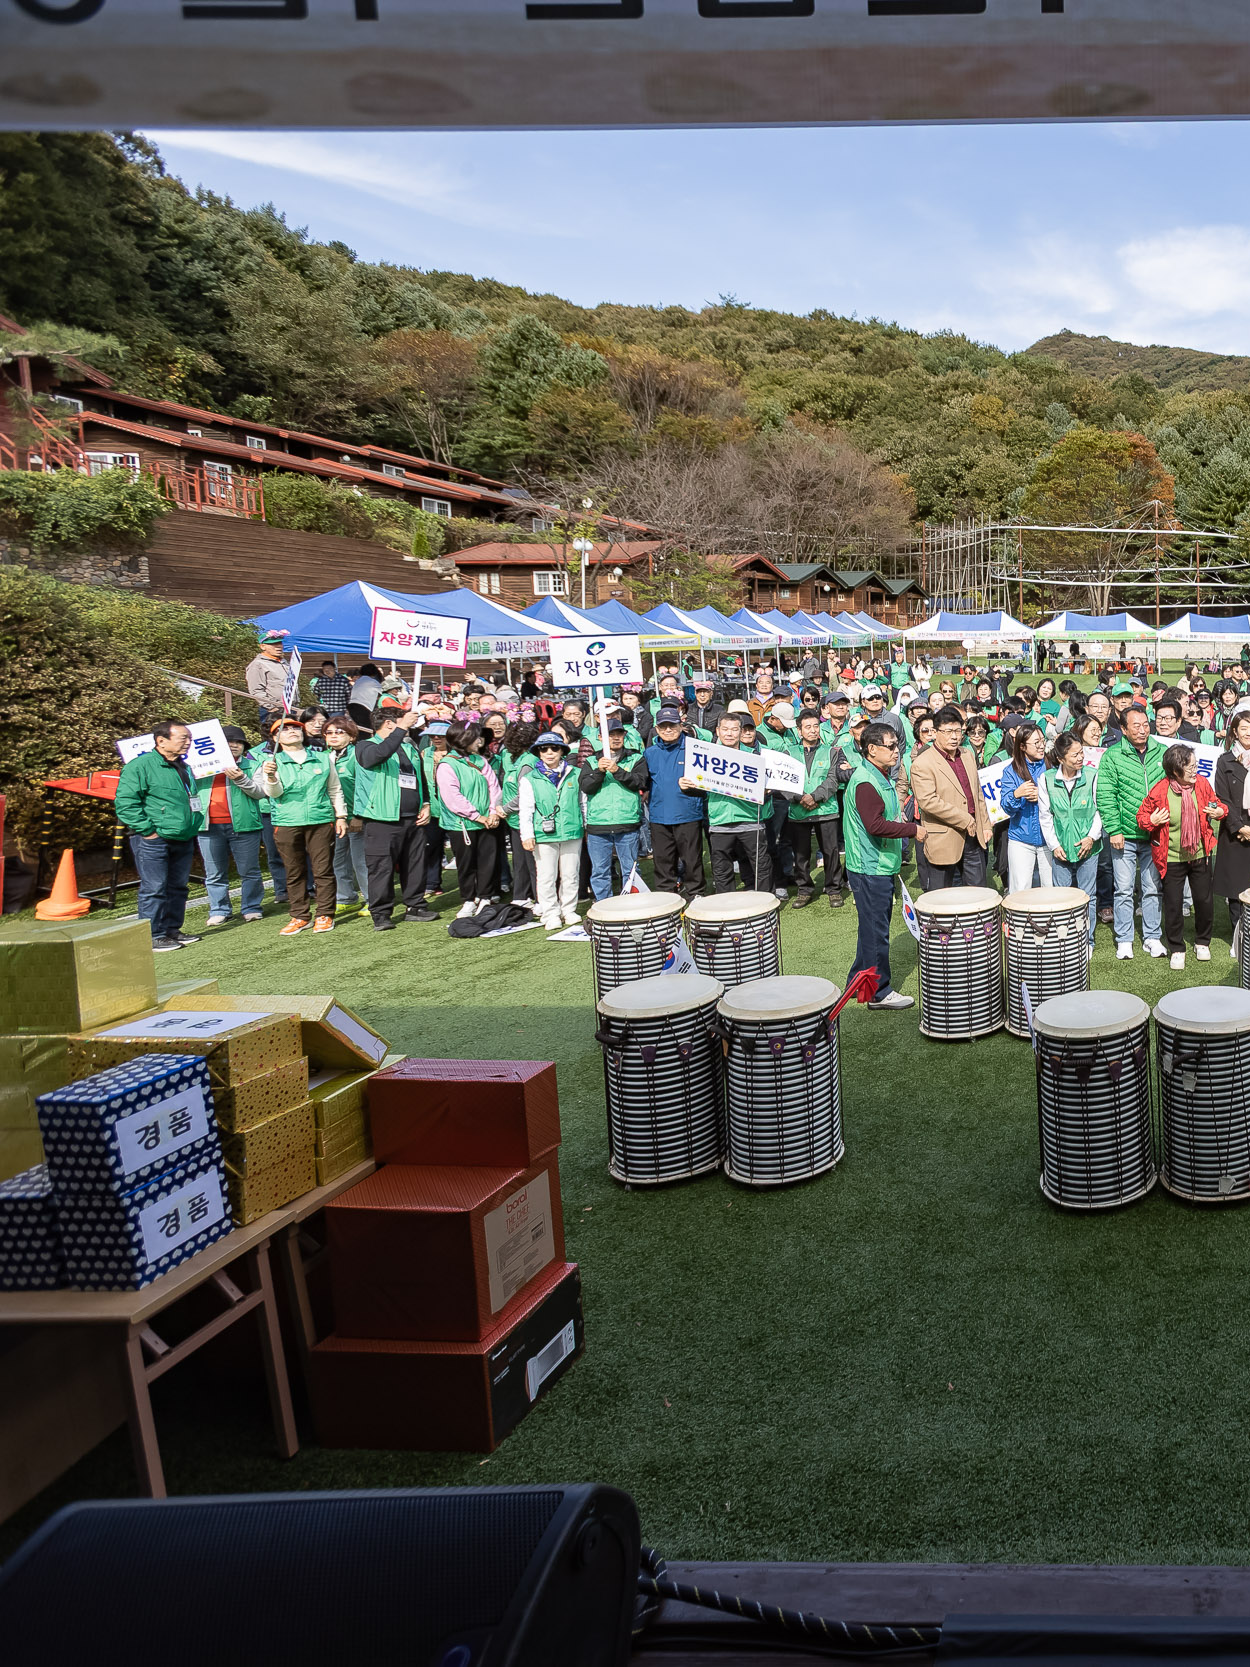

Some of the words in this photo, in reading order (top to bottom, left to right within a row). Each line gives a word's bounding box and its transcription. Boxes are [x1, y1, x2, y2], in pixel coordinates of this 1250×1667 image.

[379, 631, 460, 652] 자양제4동
[564, 658, 631, 677] 자양3동
[692, 752, 759, 784] 자양2동
[135, 1106, 193, 1151] 경품
[156, 1192, 210, 1238] 경품
[505, 1213, 516, 1233] THE
